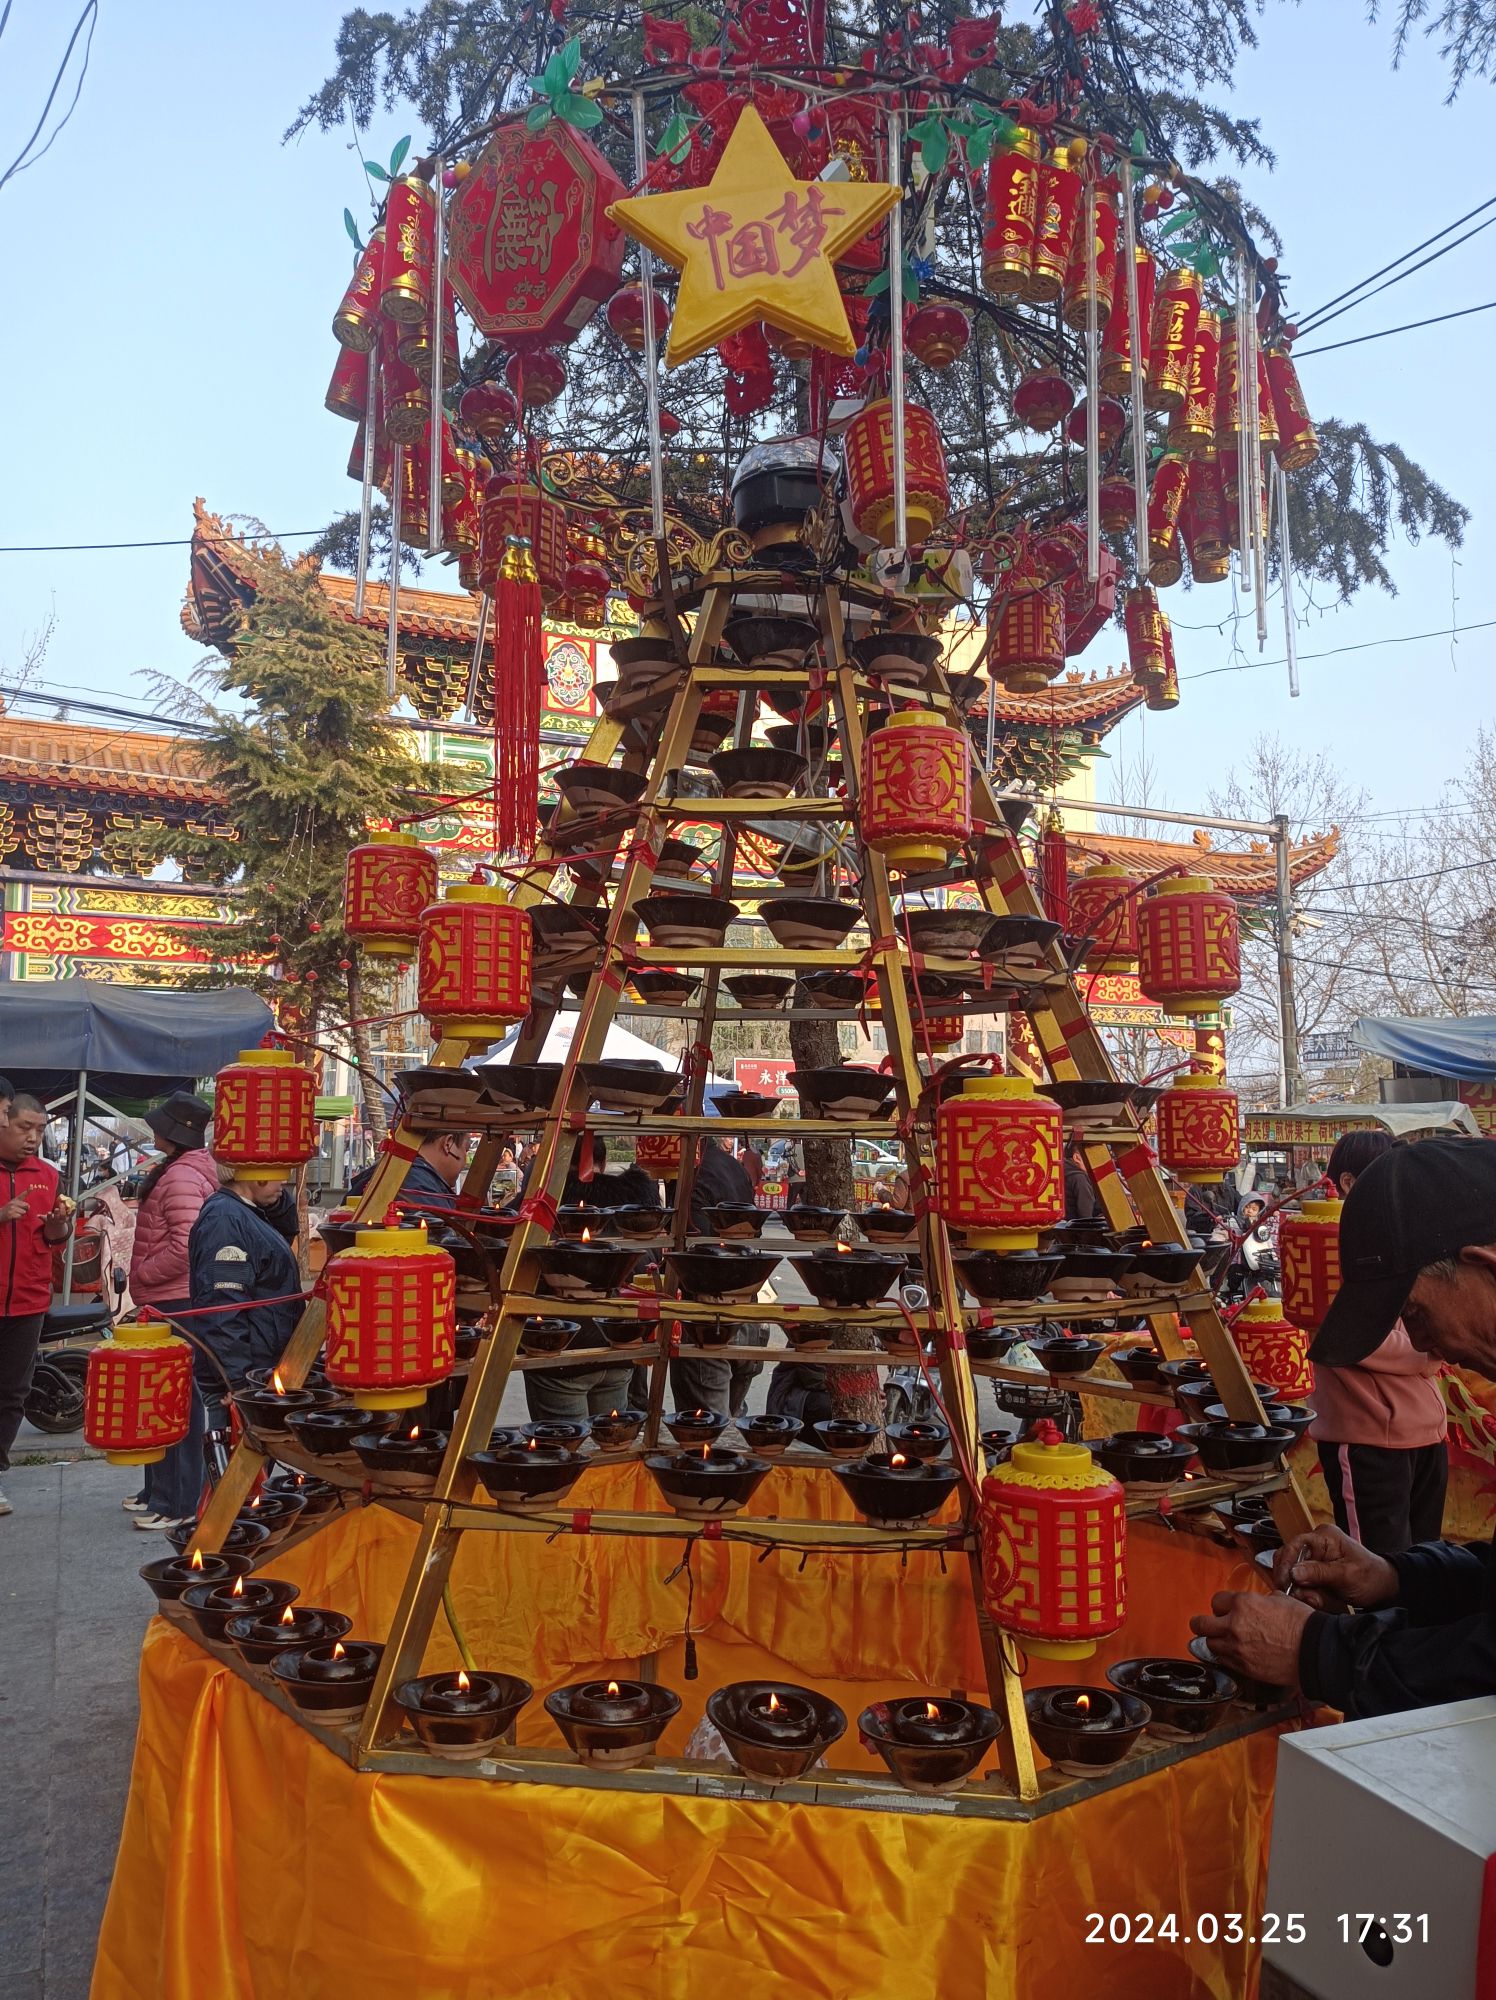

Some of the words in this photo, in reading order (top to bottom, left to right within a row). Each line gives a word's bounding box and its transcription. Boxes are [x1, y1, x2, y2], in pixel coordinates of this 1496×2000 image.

[686, 185, 846, 292] 中国梦
[978, 1131, 1046, 1197] 福
[1275, 1121, 1313, 1142] 煎饼果子
